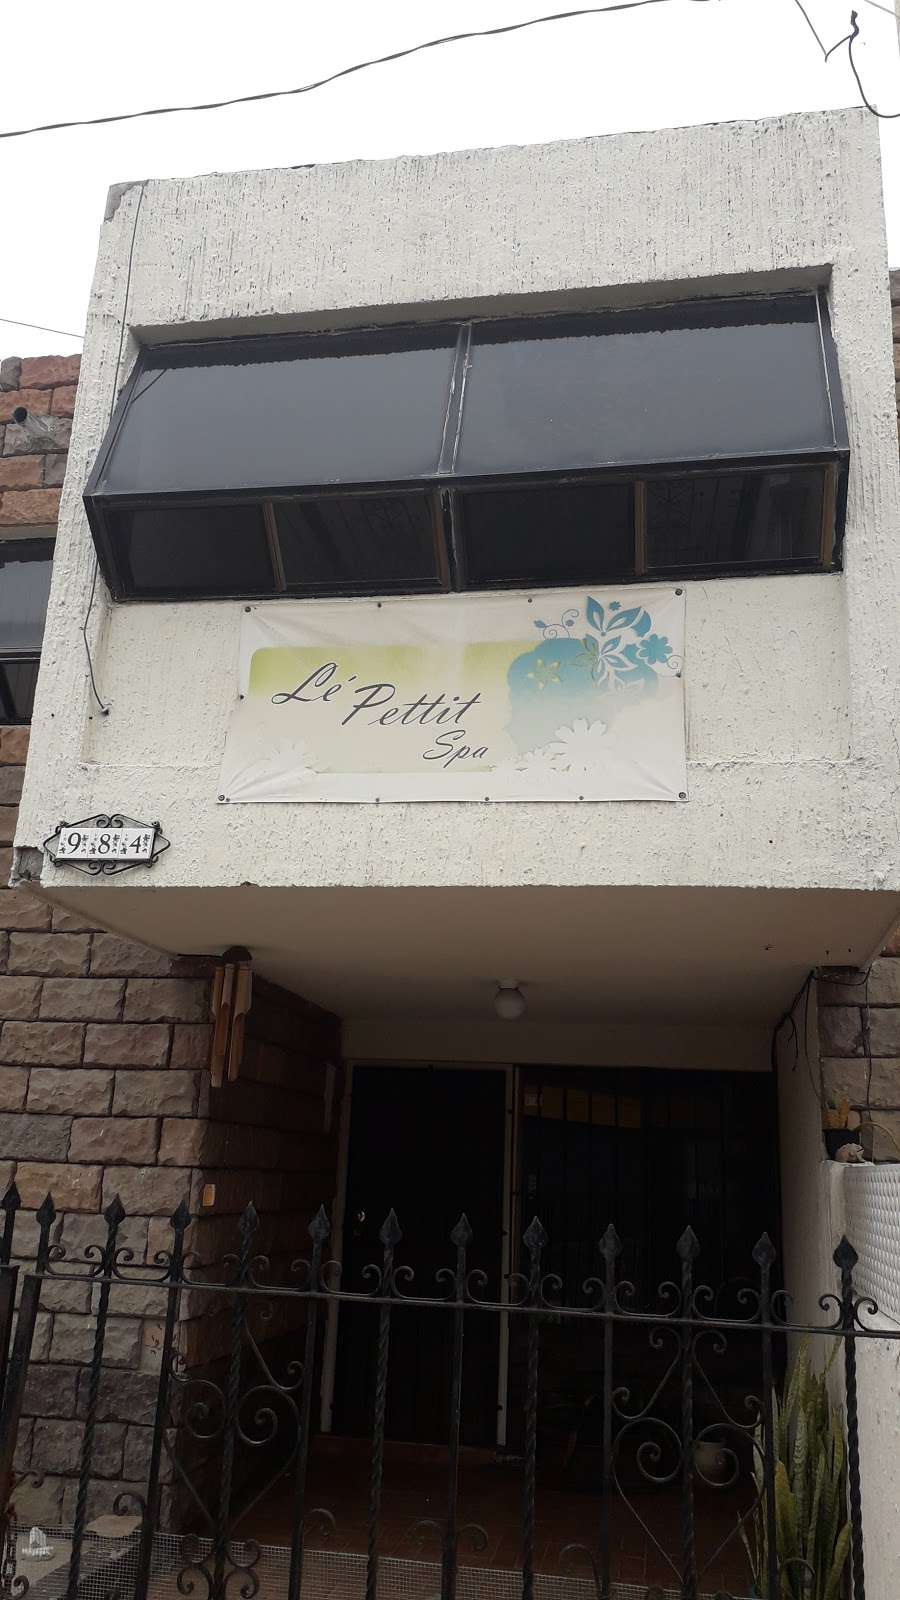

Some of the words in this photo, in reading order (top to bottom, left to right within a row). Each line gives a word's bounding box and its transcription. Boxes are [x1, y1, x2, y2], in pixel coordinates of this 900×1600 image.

[341, 683, 482, 726] Pettit
[422, 729, 488, 768] Spa
[67, 832, 142, 854] 984
